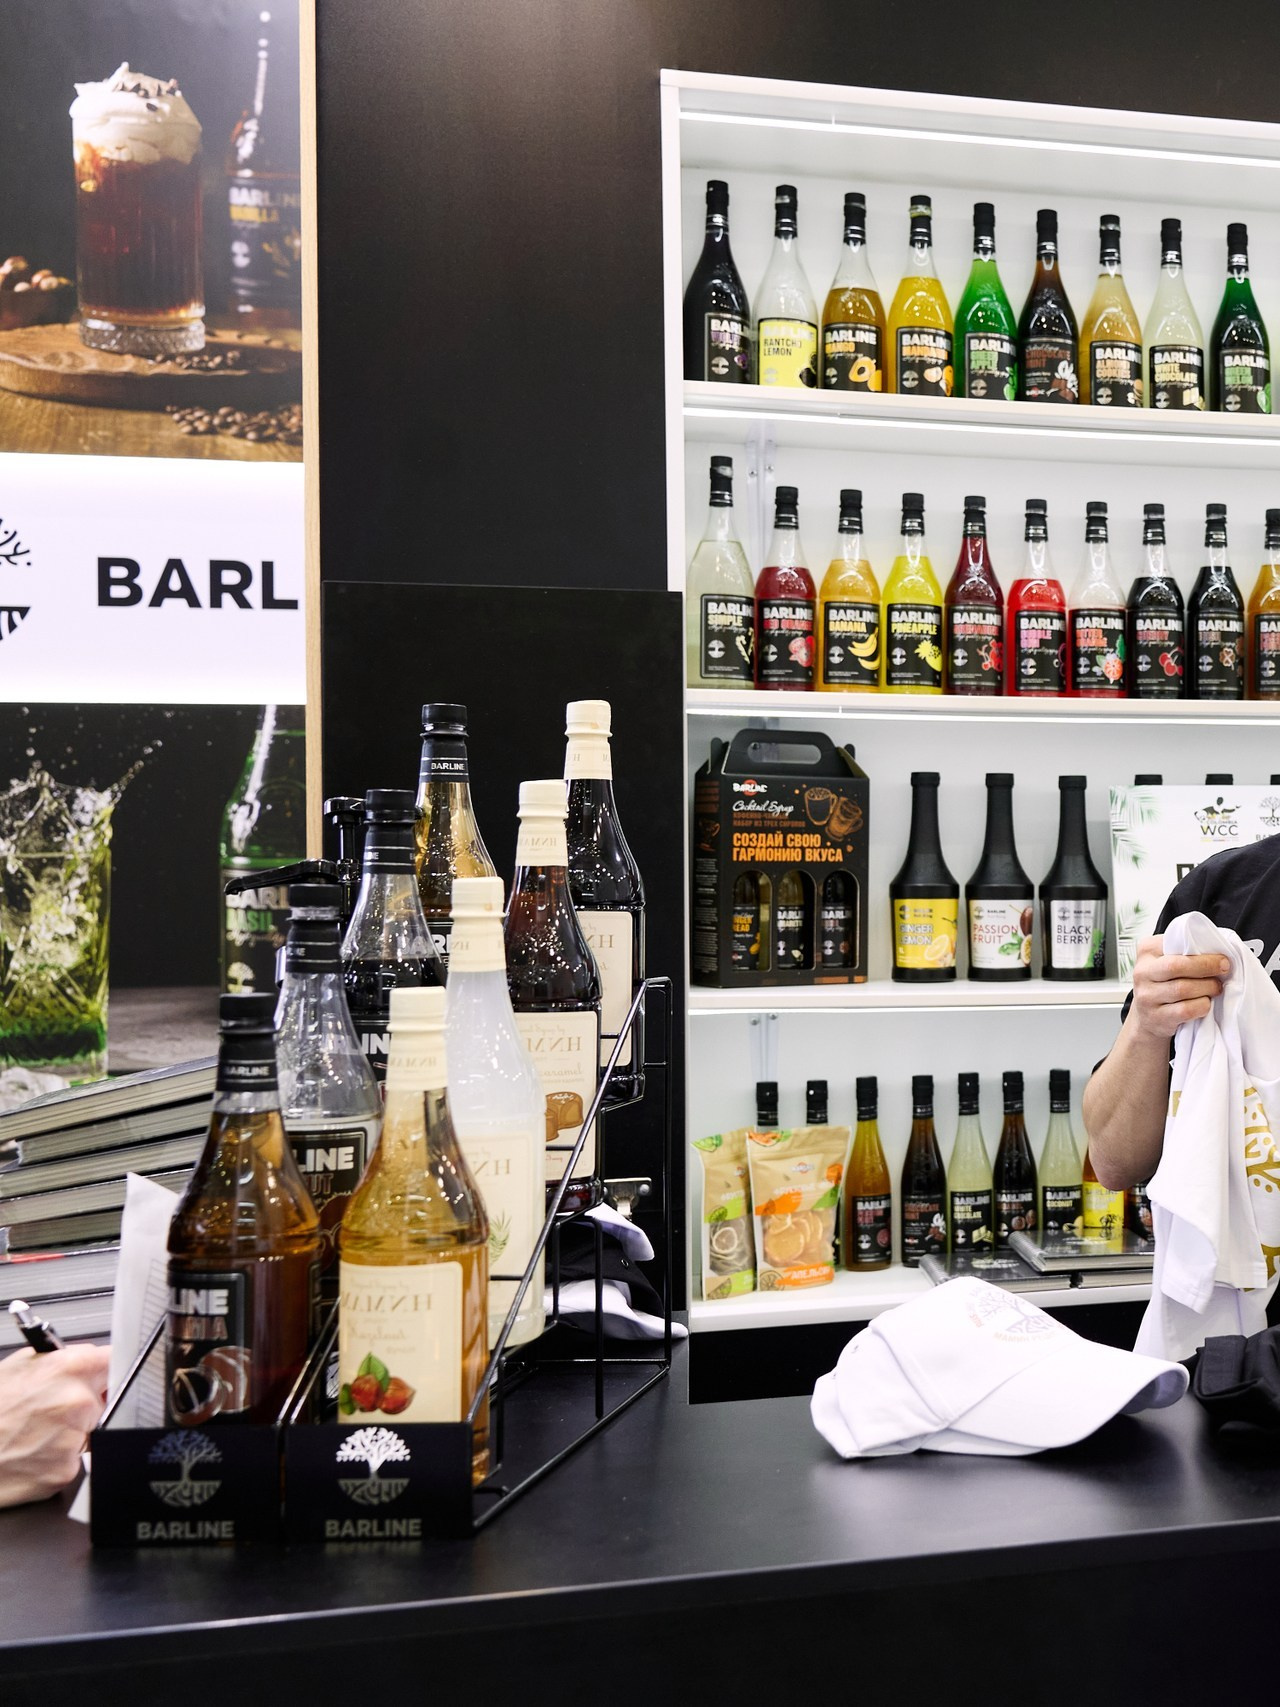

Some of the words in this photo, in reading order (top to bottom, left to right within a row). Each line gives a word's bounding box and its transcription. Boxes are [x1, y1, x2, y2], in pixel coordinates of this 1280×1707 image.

[825, 330, 877, 346] BARLINE
[763, 347, 793, 358] LEMON
[98, 556, 299, 610] BARL
[763, 606, 813, 624] BARLINE
[707, 616, 743, 631] SIMPLE
[828, 619, 867, 634] BANANA
[891, 622, 937, 638] PINEAPPLE
[430, 761, 466, 772] BARLINE
[732, 799, 769, 812] Cocktail
[769, 800, 794, 817] Syrup
[1200, 824, 1239, 836] WCC
[732, 830, 784, 848] СОЗДАЙ
[786, 833, 822, 848] СВОЮ
[732, 847, 802, 862] ГАРМОНИЮ
[804, 848, 843, 862] ВКУСА
[899, 923, 934, 934] GINGER
[973, 924, 1019, 936] PASSION
[1056, 924, 1091, 936] BLACK
[900, 935, 933, 946] LEMON
[973, 934, 1004, 945] FRUIT
[1056, 935, 1091, 946] BERRY
[527, 1036, 582, 1052] МИН
[543, 1061, 582, 1076] aramel
[137, 1520, 235, 1541] BARLINE
[325, 1518, 422, 1538] BARLINE
